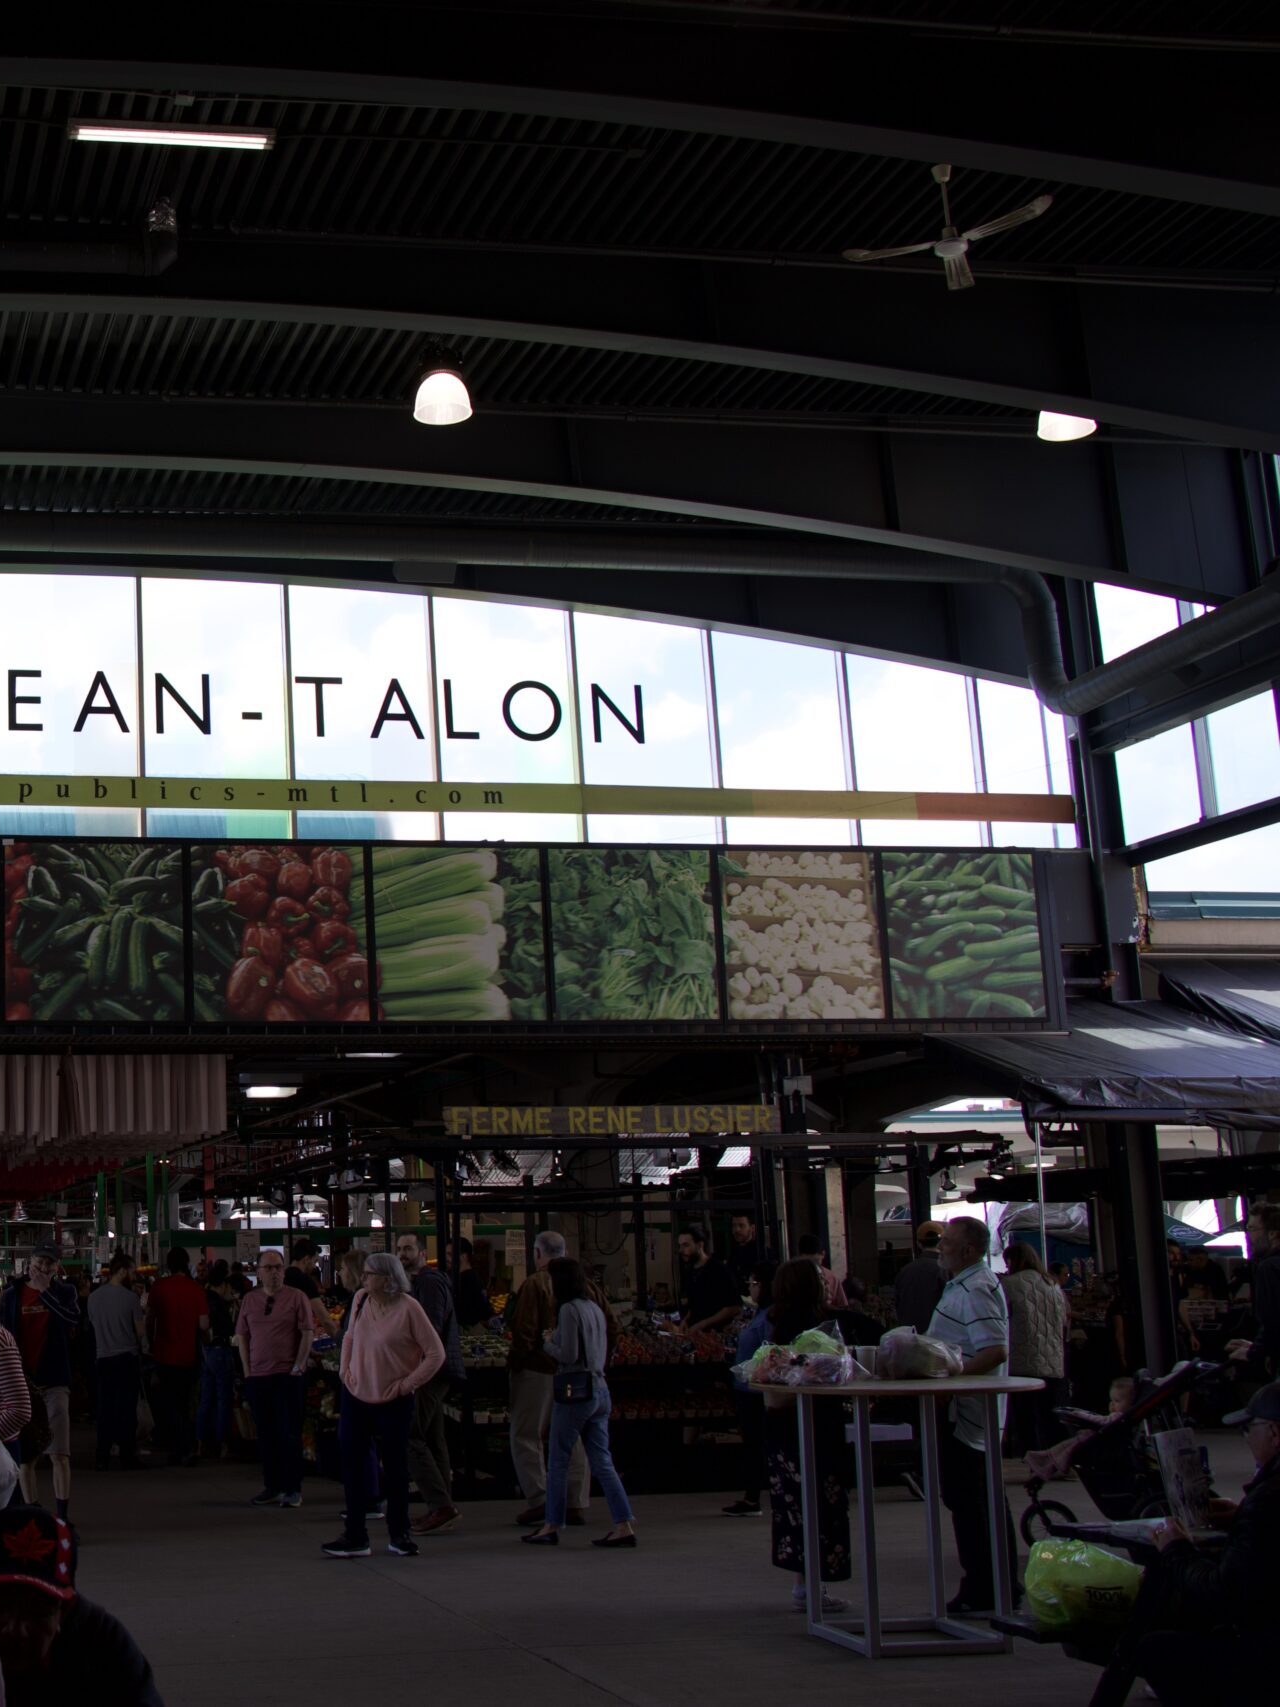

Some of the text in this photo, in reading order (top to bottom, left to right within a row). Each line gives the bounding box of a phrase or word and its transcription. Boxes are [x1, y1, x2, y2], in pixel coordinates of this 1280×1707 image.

[449, 1104, 771, 1135] FERME RENE LUSSIER
